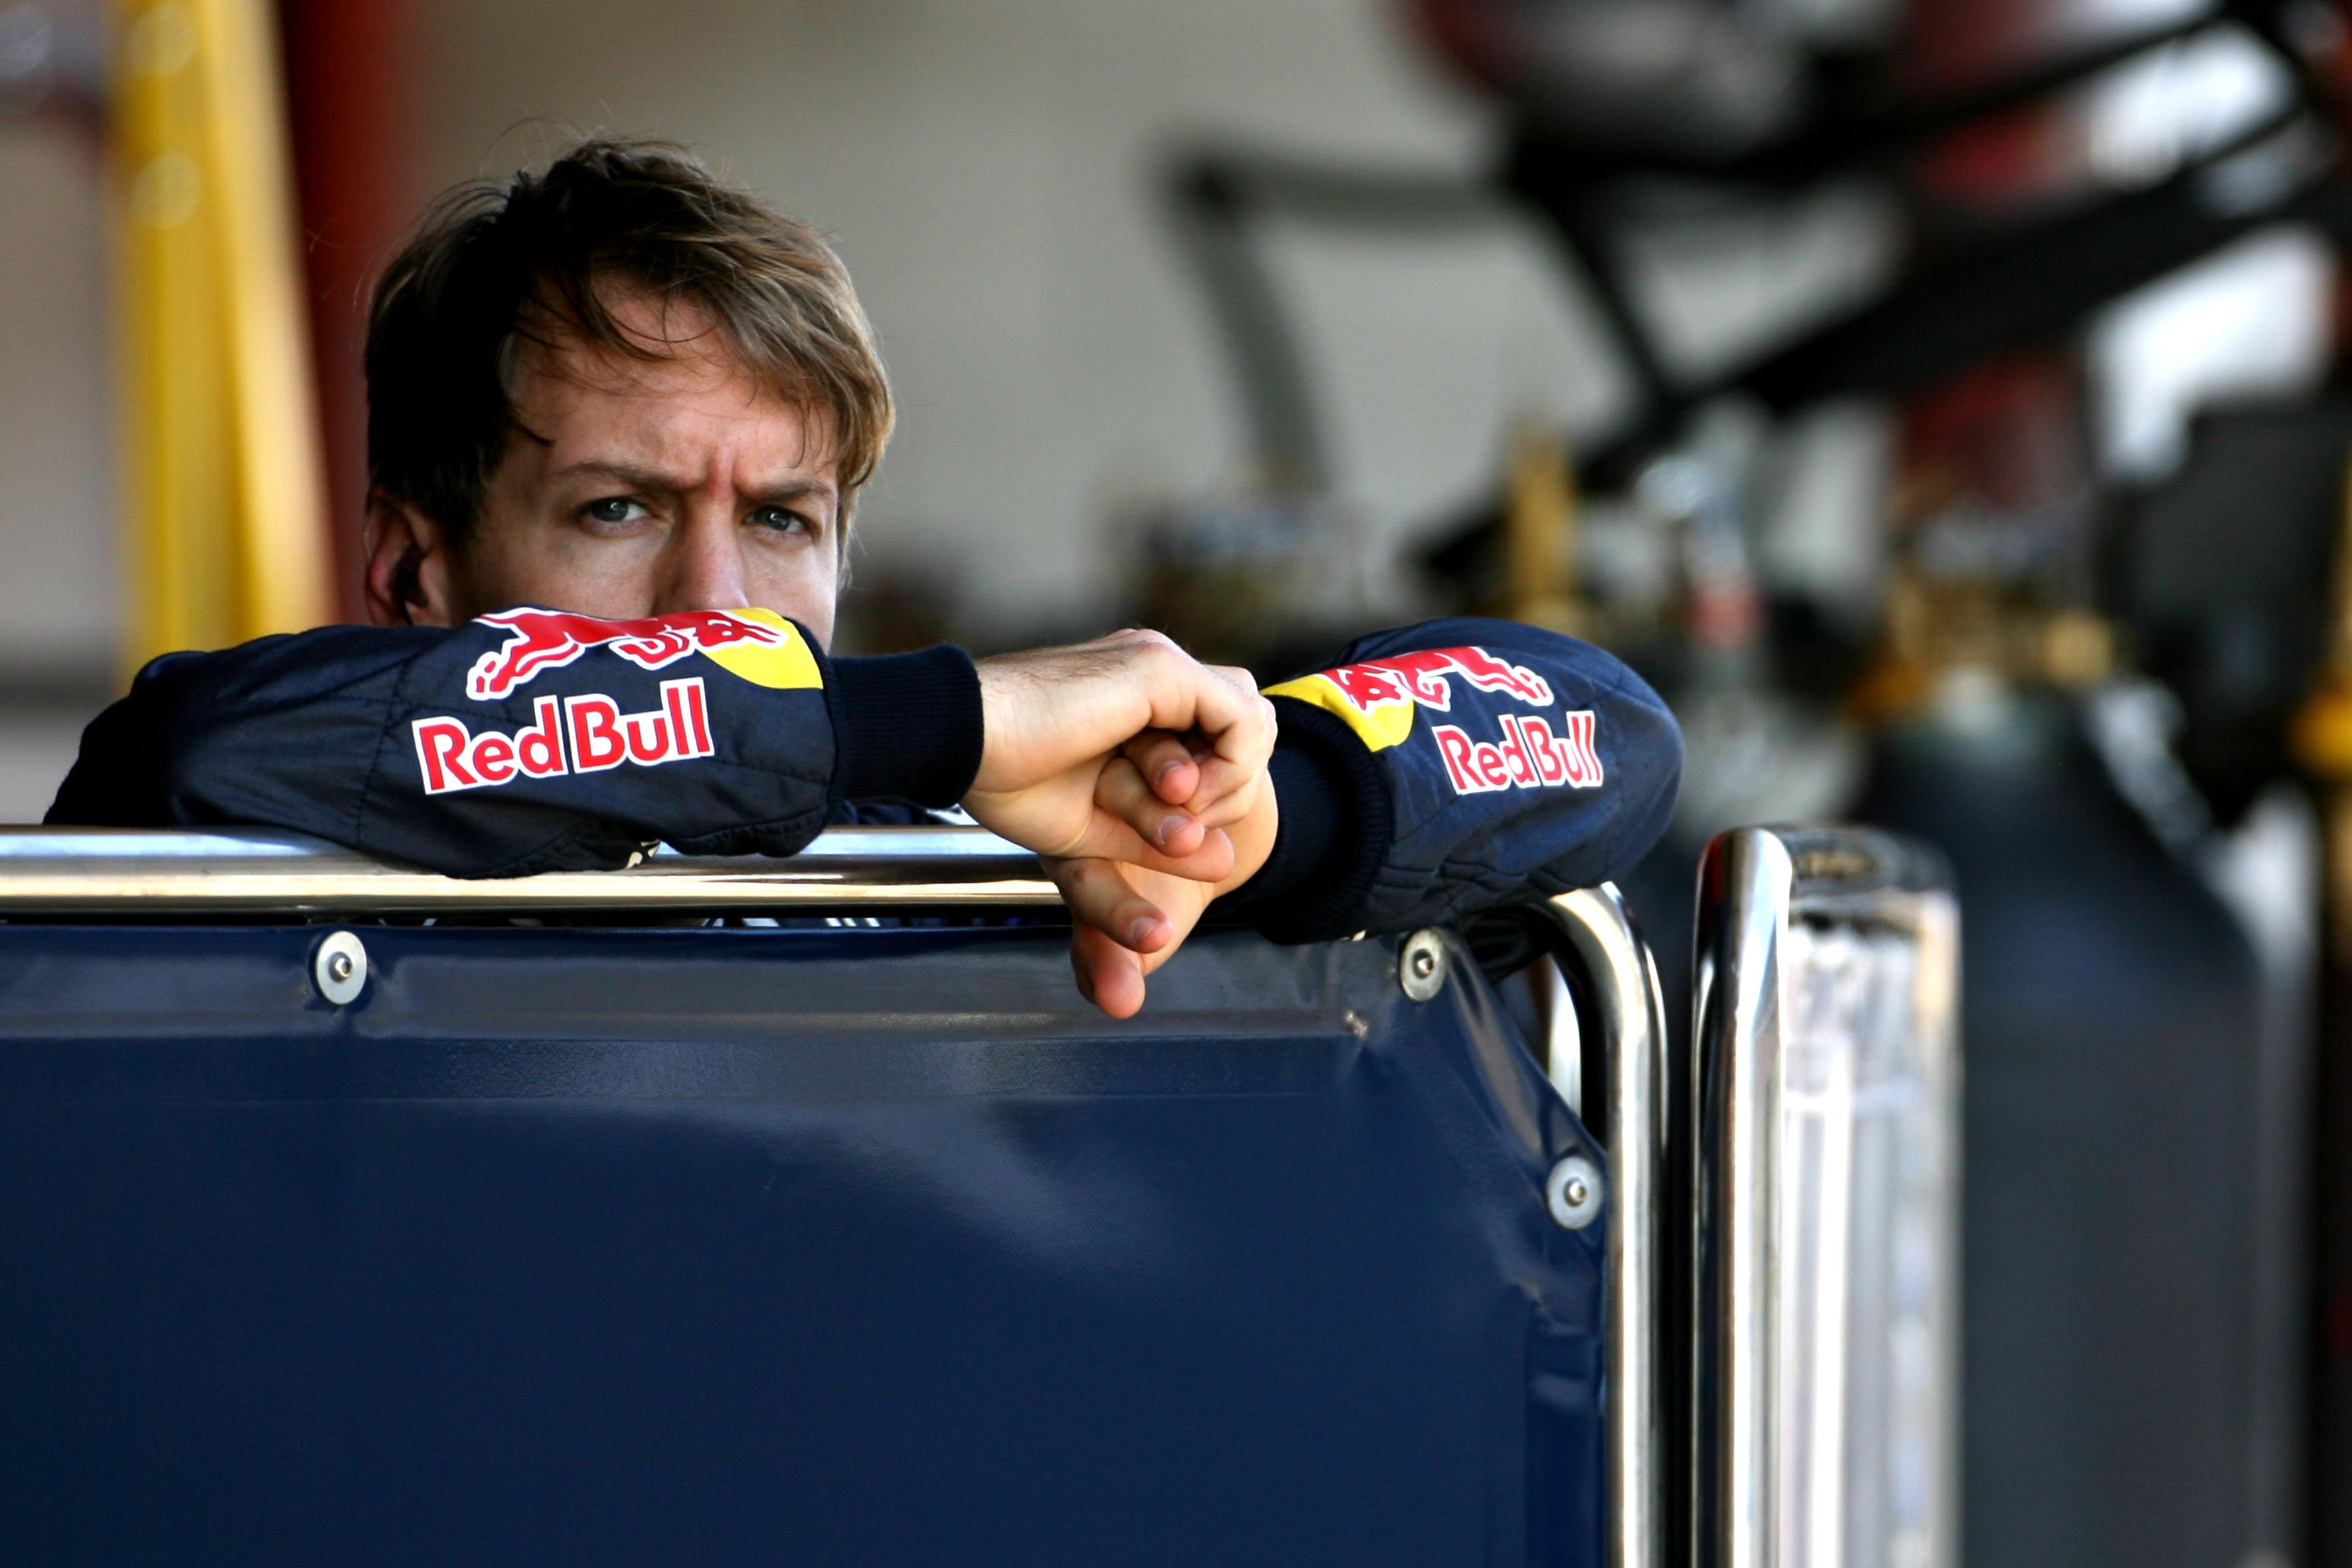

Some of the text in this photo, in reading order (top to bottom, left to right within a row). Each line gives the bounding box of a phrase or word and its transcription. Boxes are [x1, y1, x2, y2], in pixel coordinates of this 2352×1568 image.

[414, 680, 713, 794] Red Bull
[1434, 712, 1603, 793] Red Bull
